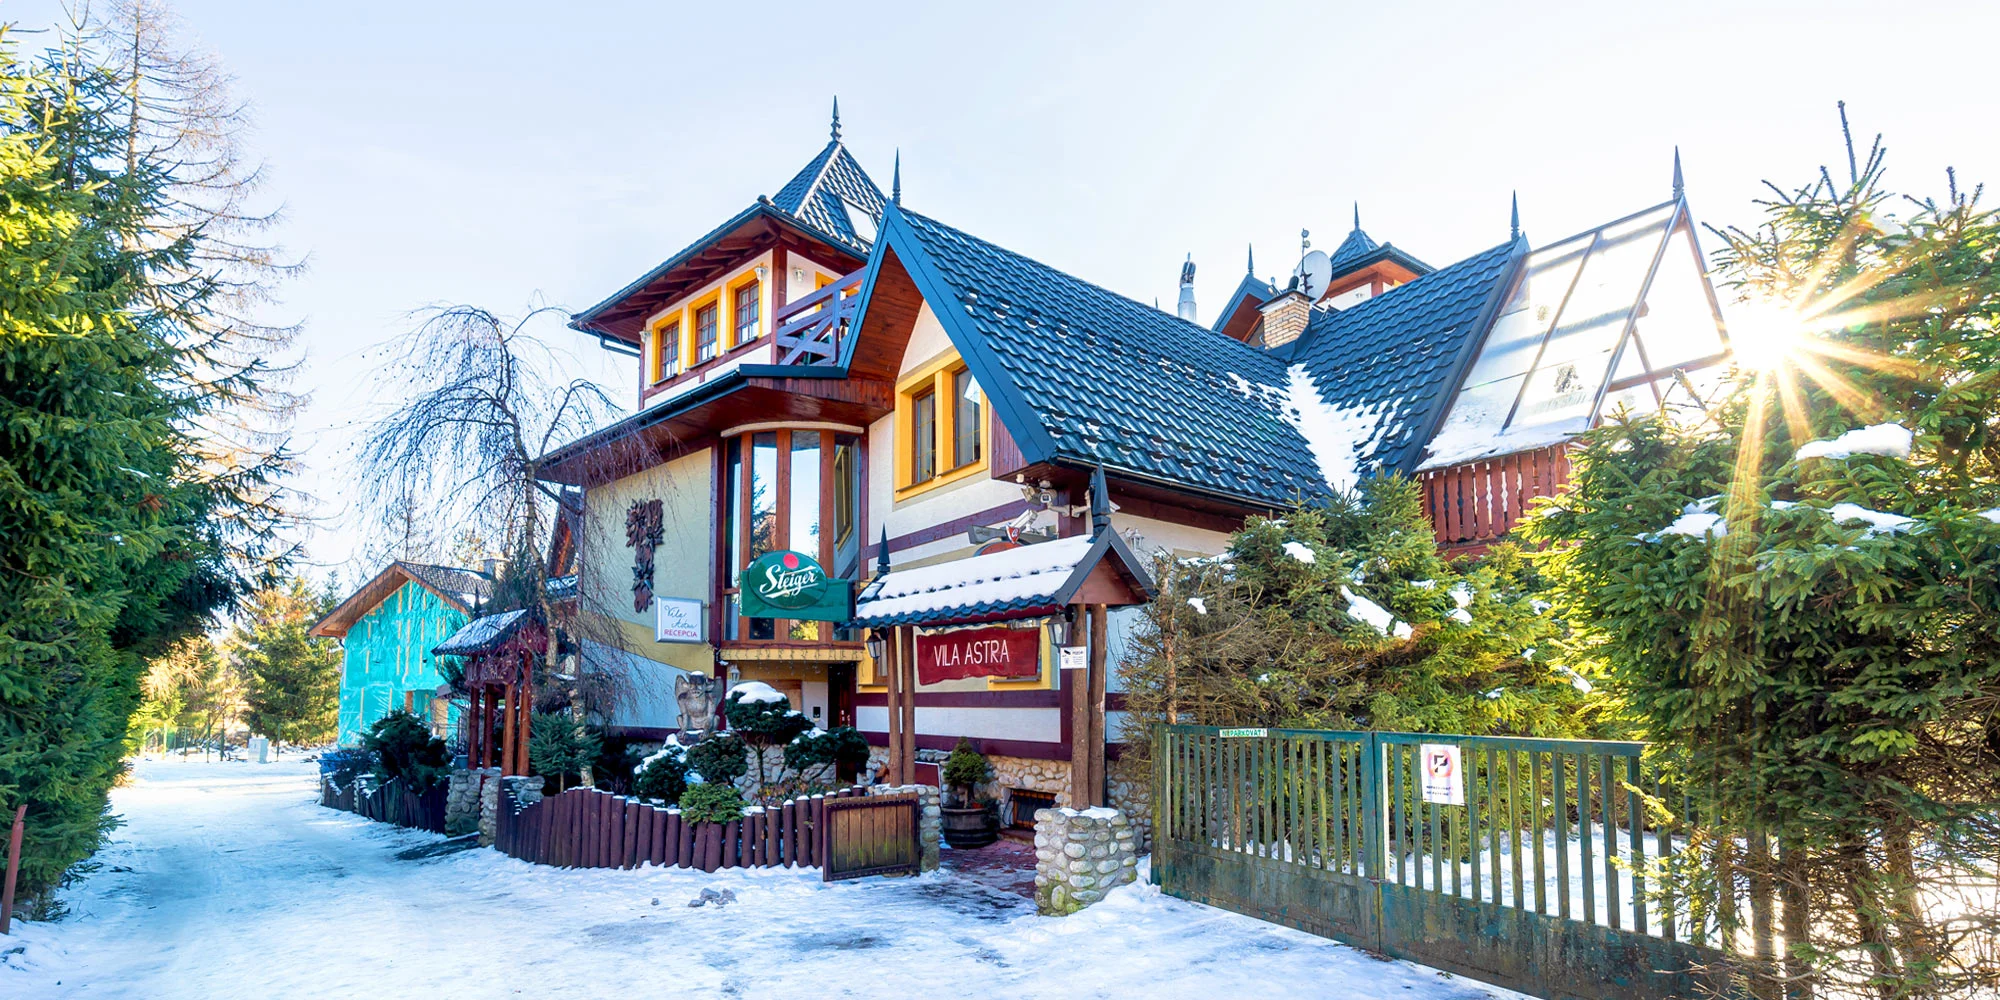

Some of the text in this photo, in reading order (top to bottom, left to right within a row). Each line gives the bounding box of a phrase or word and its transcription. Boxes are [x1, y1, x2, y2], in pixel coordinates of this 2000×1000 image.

[760, 564, 818, 596] Steiger
[664, 629, 697, 637] RECEPCIA
[934, 639, 1010, 667] VILA ASTRA
